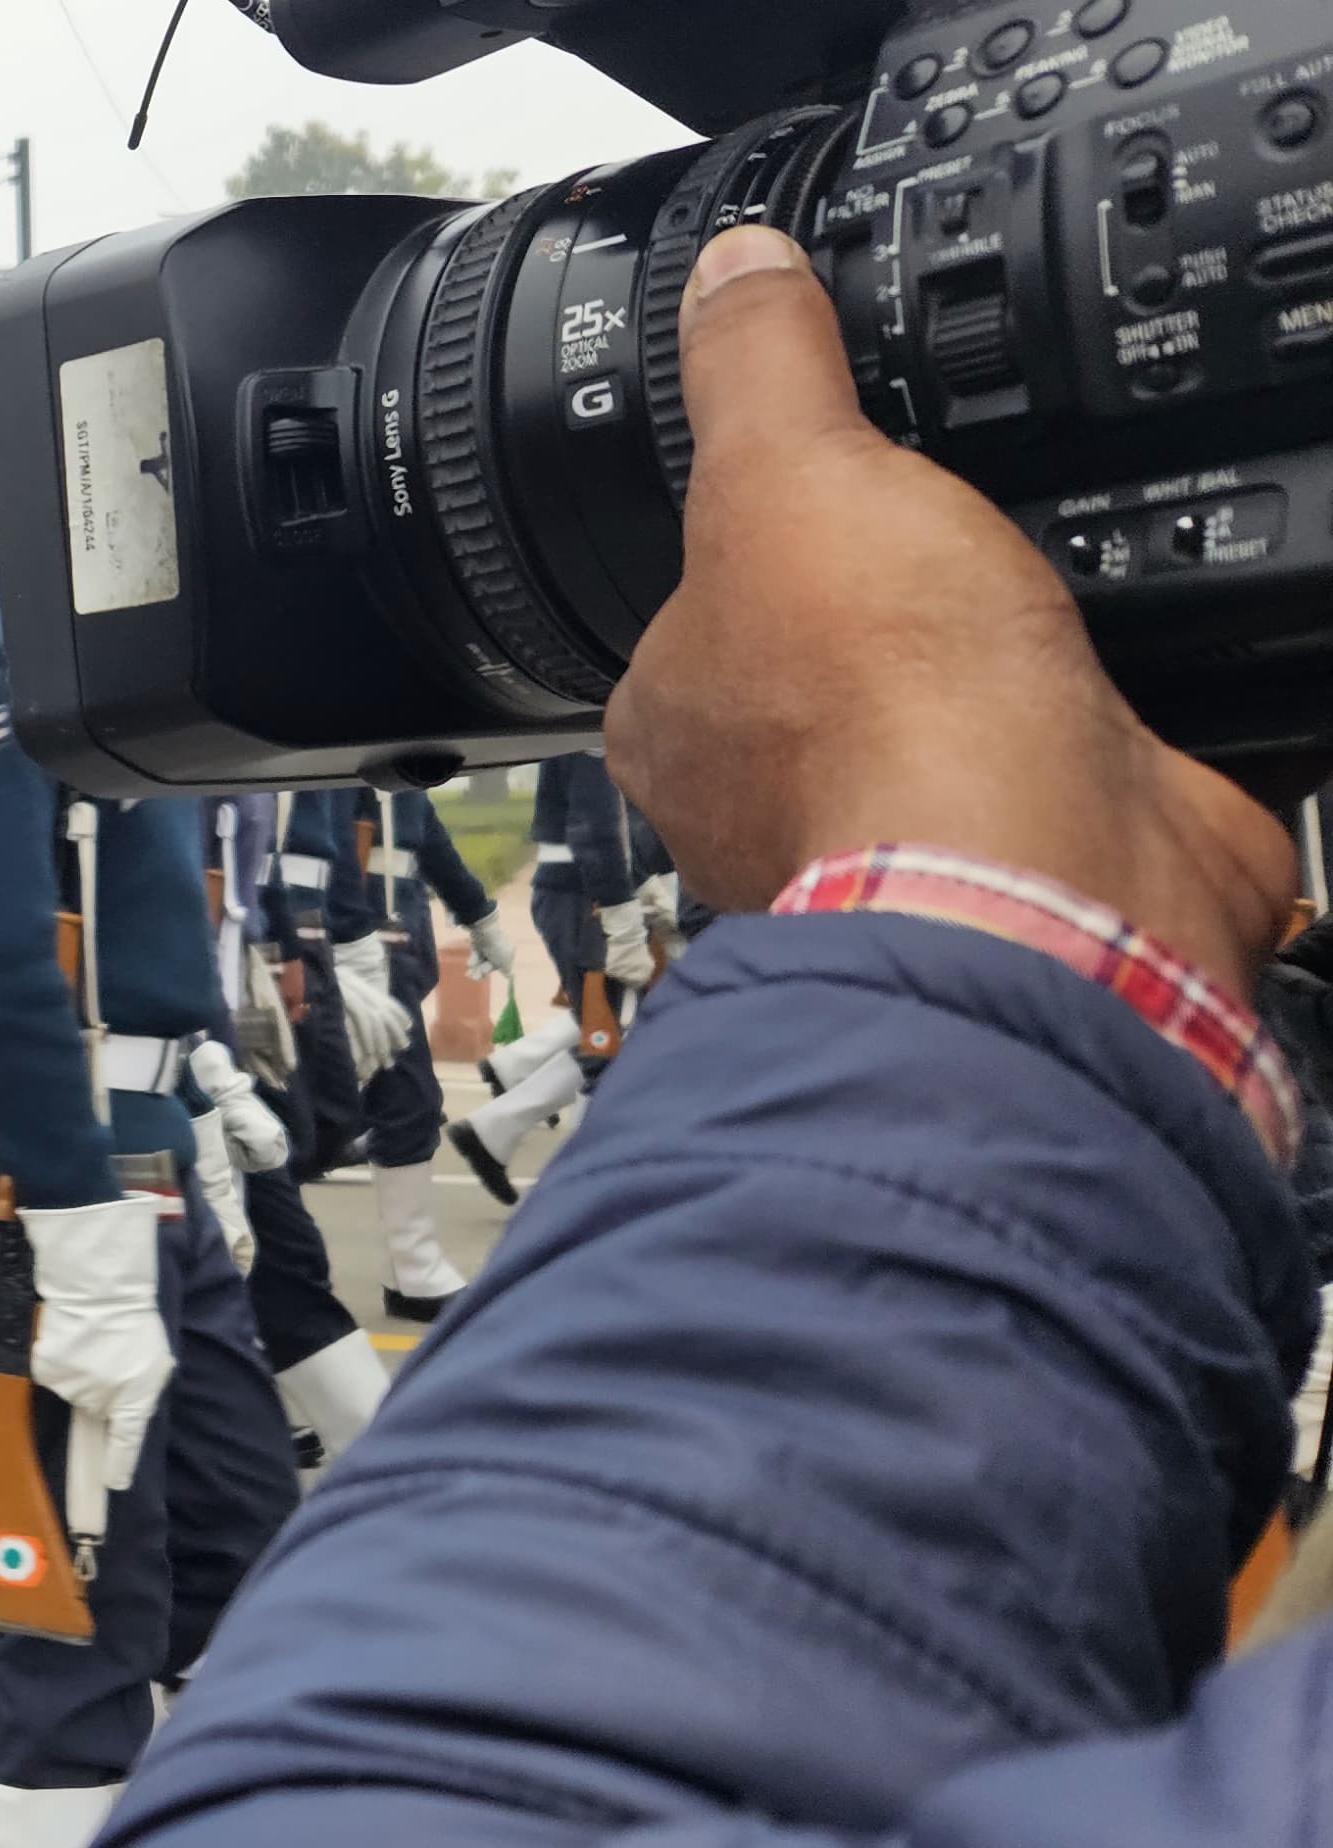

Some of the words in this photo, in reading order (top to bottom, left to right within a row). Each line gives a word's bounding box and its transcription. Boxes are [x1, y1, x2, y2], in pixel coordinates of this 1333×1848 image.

[1103, 103, 1181, 137] FOCUS
[1175, 180, 1217, 204] MAN
[1115, 309, 1200, 345] SHUTTER
[561, 333, 609, 359] OPTICAL
[561, 351, 599, 374] ZOOM
[381, 388, 400, 407] G
[571, 381, 614, 418] G
[384, 406, 403, 462] Lens
[390, 464, 413, 517] Sony
[1058, 492, 1112, 518] GAIN
